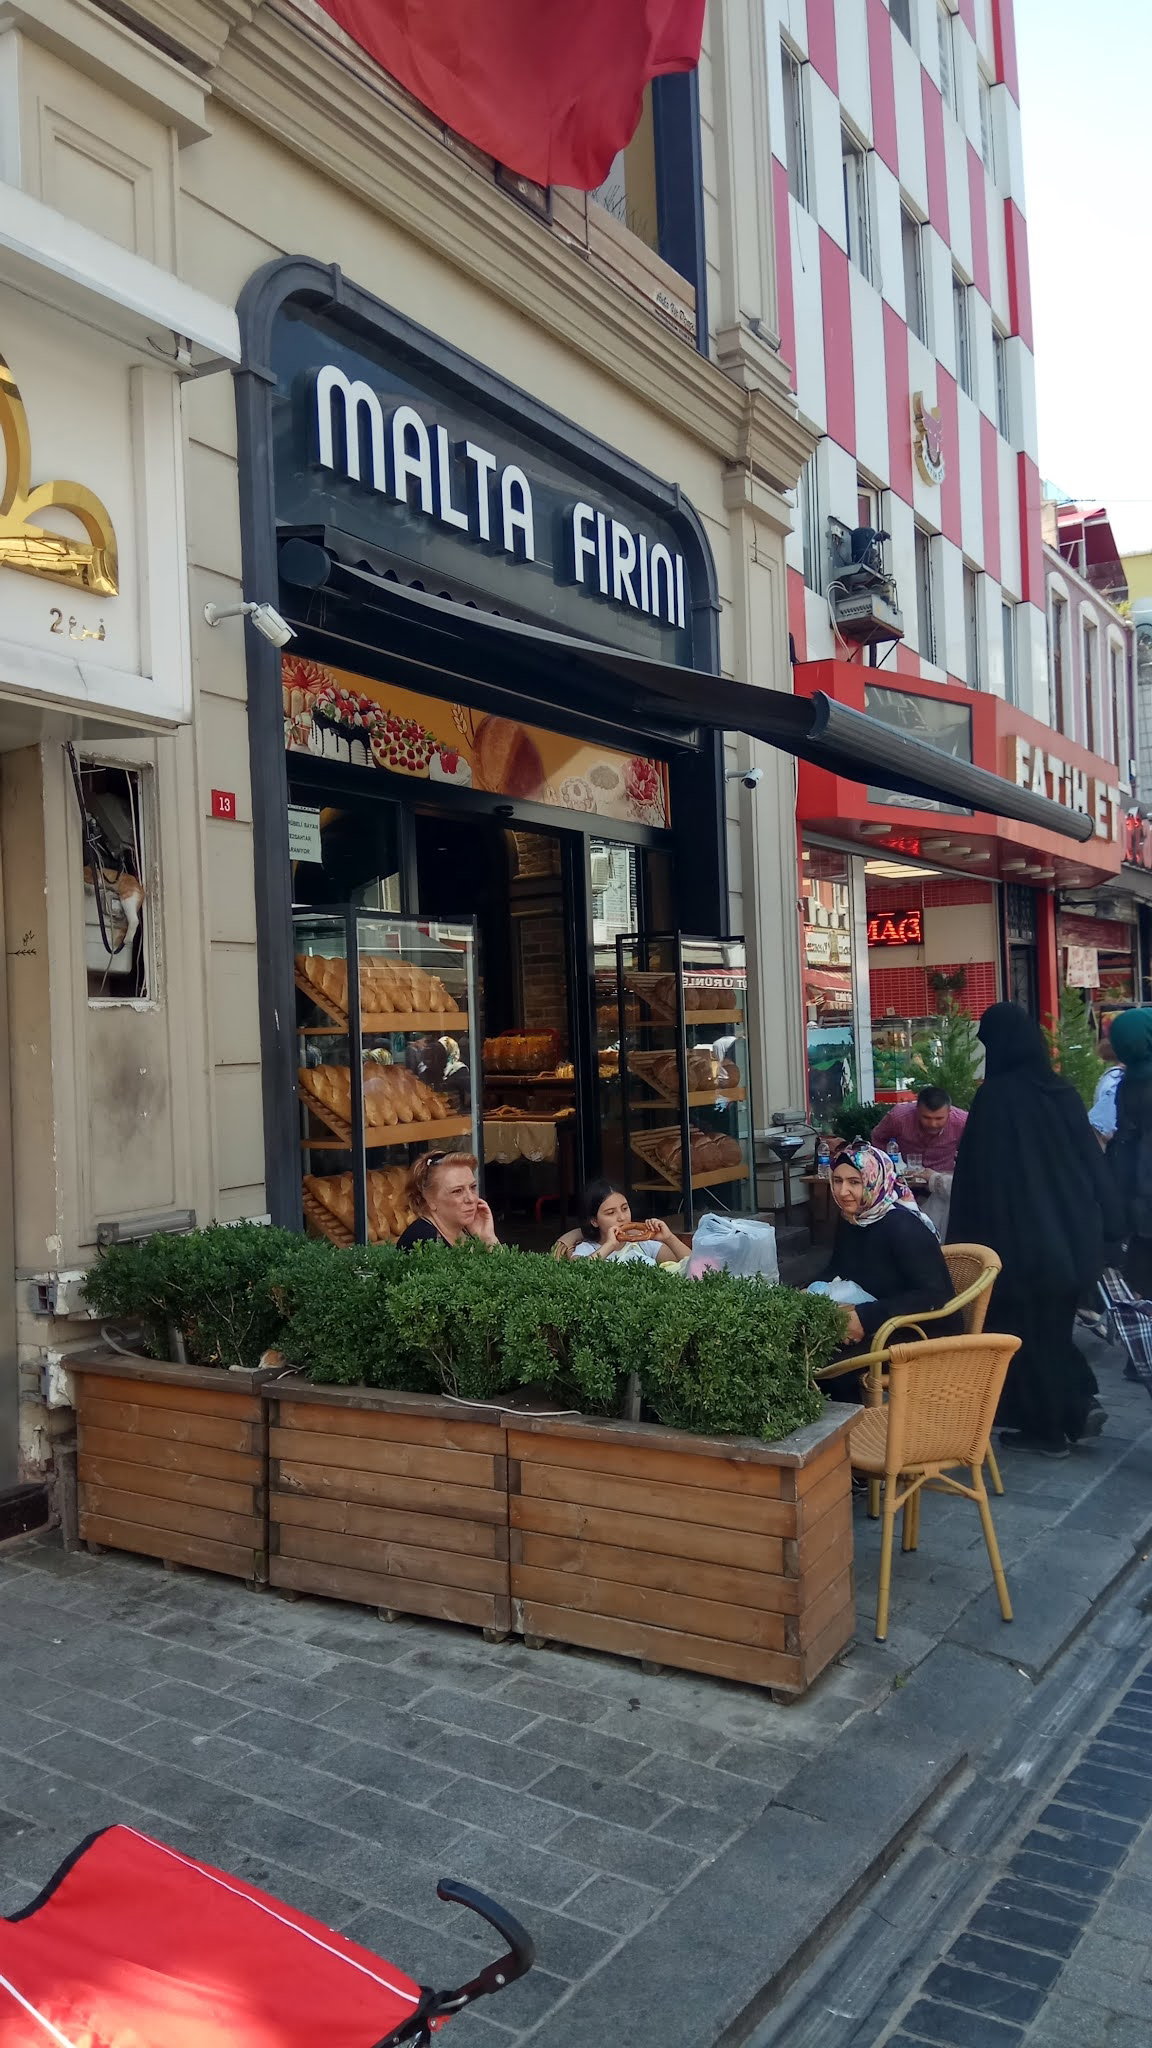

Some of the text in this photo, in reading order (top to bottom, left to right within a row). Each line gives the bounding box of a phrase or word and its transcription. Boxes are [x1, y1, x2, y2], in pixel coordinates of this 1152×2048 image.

[316, 365, 685, 630] MALTA FIRINI
[49, 607, 64, 635] 2
[219, 797, 231, 812] 13
[1094, 777, 1121, 843] ET
